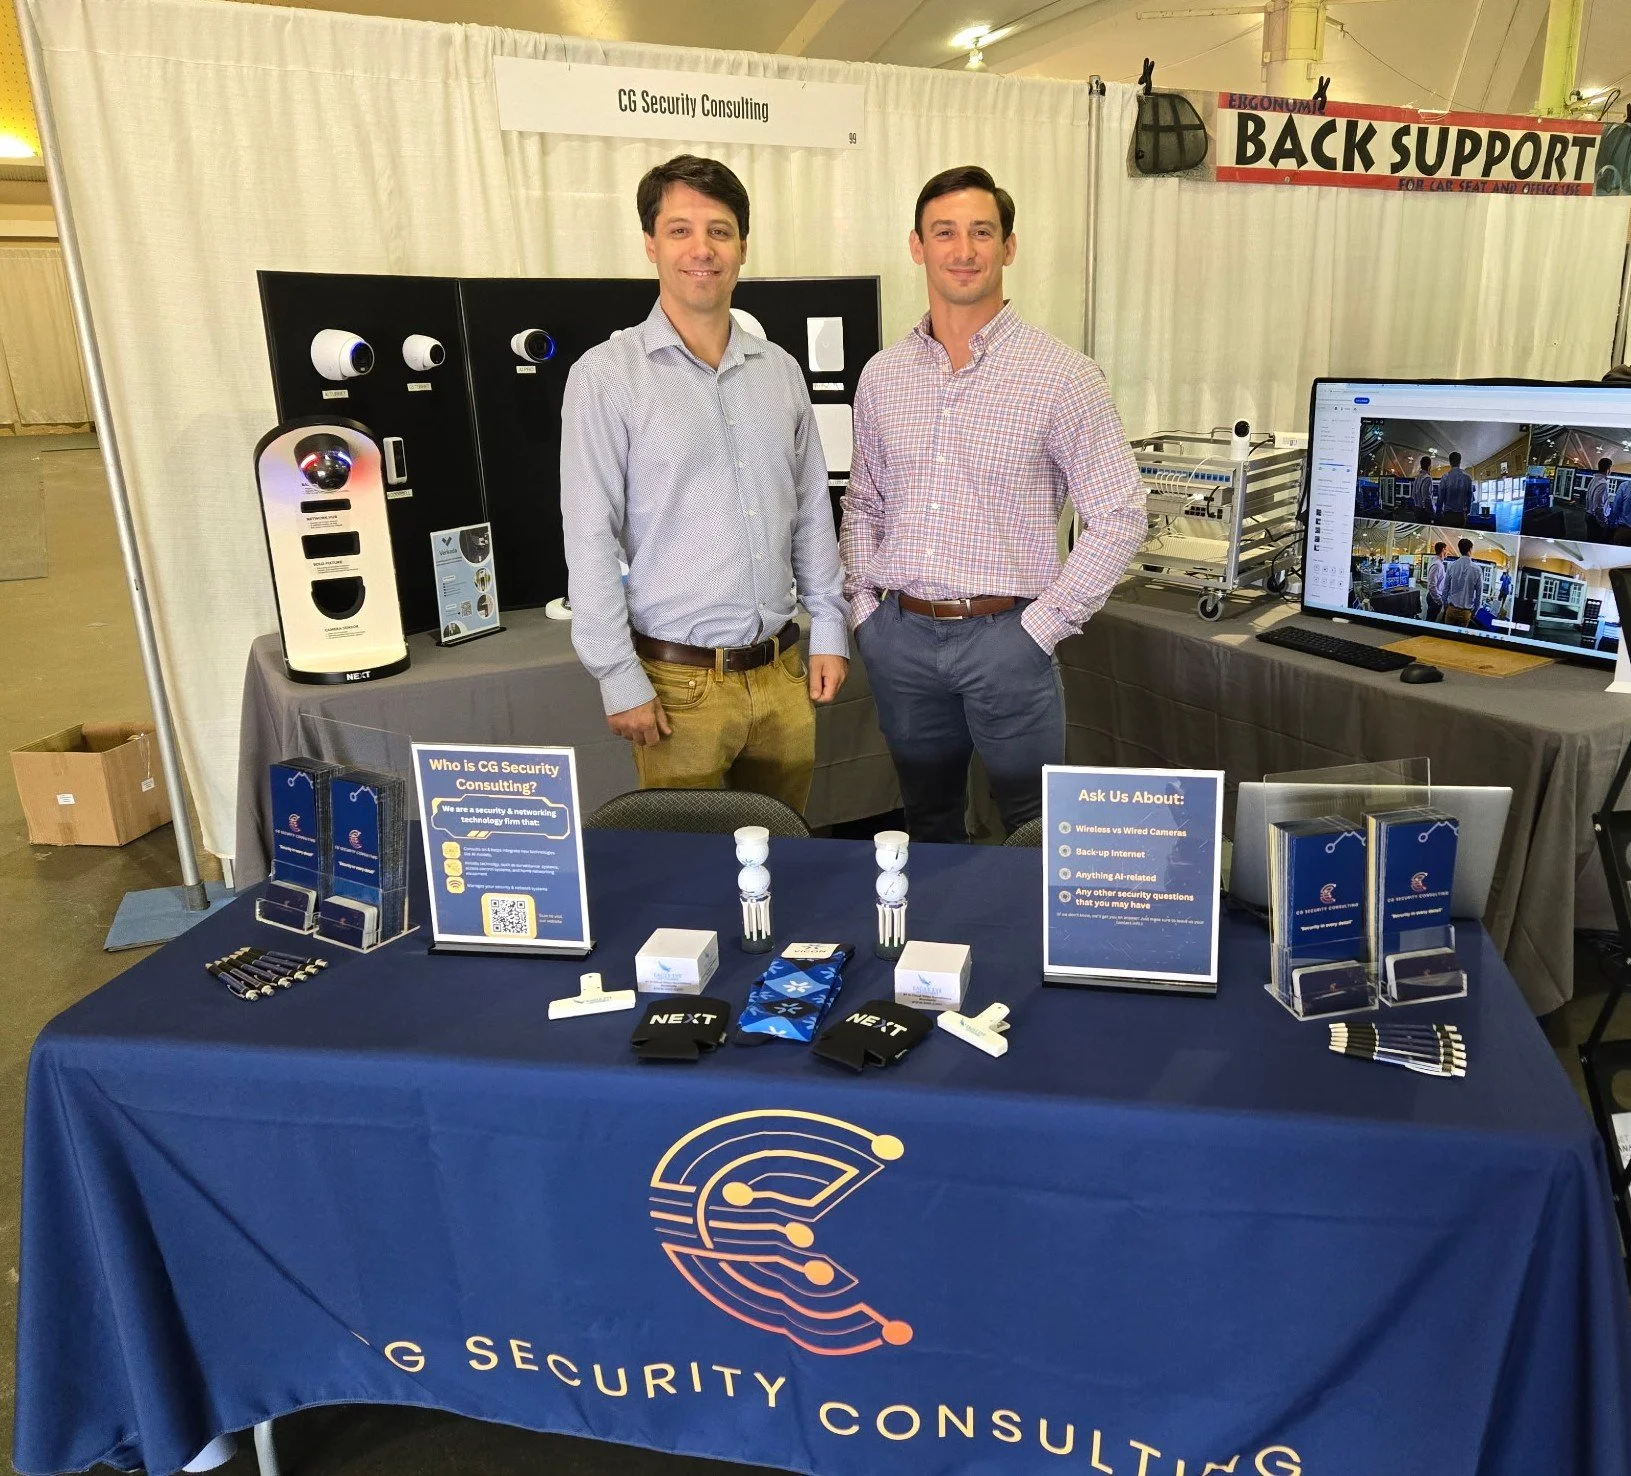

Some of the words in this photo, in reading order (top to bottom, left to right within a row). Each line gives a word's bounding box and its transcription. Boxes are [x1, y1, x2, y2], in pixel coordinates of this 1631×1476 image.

[617, 87, 638, 113] CG
[640, 89, 697, 119] Security
[700, 93, 770, 124] Consulting
[848, 132, 858, 145] 99
[1234, 111, 1378, 173] BACK
[1389, 123, 1597, 182] SUPPORT
[1398, 177, 1425, 192] FOR
[1429, 179, 1454, 193] CAR
[1458, 180, 1488, 194] SEAT
[1491, 182, 1518, 195] AND
[1521, 182, 1559, 196] OFFICE
[439, 548, 458, 556] Verkada
[346, 670, 371, 681] NEXT
[428, 758, 461, 771] Who
[463, 760, 476, 772] is
[478, 761, 499, 773] CG
[501, 761, 560, 778] Security
[455, 778, 538, 796] Consulting?
[1078, 789, 1106, 802] Ask
[1109, 790, 1129, 803] Us
[1132, 791, 1185, 805] About:
[441, 805, 455, 813] We
[475, 805, 506, 816] security
[507, 807, 514, 815] &
[514, 807, 558, 819] networking
[460, 816, 504, 826] technology
[504, 817, 521, 826] firm
[521, 818, 541, 827] that:
[1075, 824, 1111, 835] Wireless
[1123, 827, 1148, 836] Wired
[1149, 828, 1187, 838] Cameras
[1075, 847, 1110, 858] Back-up
[1111, 849, 1146, 859] Internet
[1075, 871, 1114, 882] Anything
[1114, 873, 1157, 883] AI-related
[1075, 887, 1092, 898] Any
[1093, 888, 1116, 897] other
[1117, 890, 1152, 900] security
[1152, 892, 1195, 902] questions
[1075, 898, 1094, 907] that
[1094, 901, 1110, 909] you
[1111, 902, 1130, 910] may
[1130, 901, 1151, 910] have
[1304, 906, 1328, 915] SECURITY
[1328, 902, 1359, 911] CONSULTING
[649, 1012, 717, 1025] NEXT
[845, 1012, 908, 1037] NEXT
[464, 1335, 787, 1409] SECURITY
